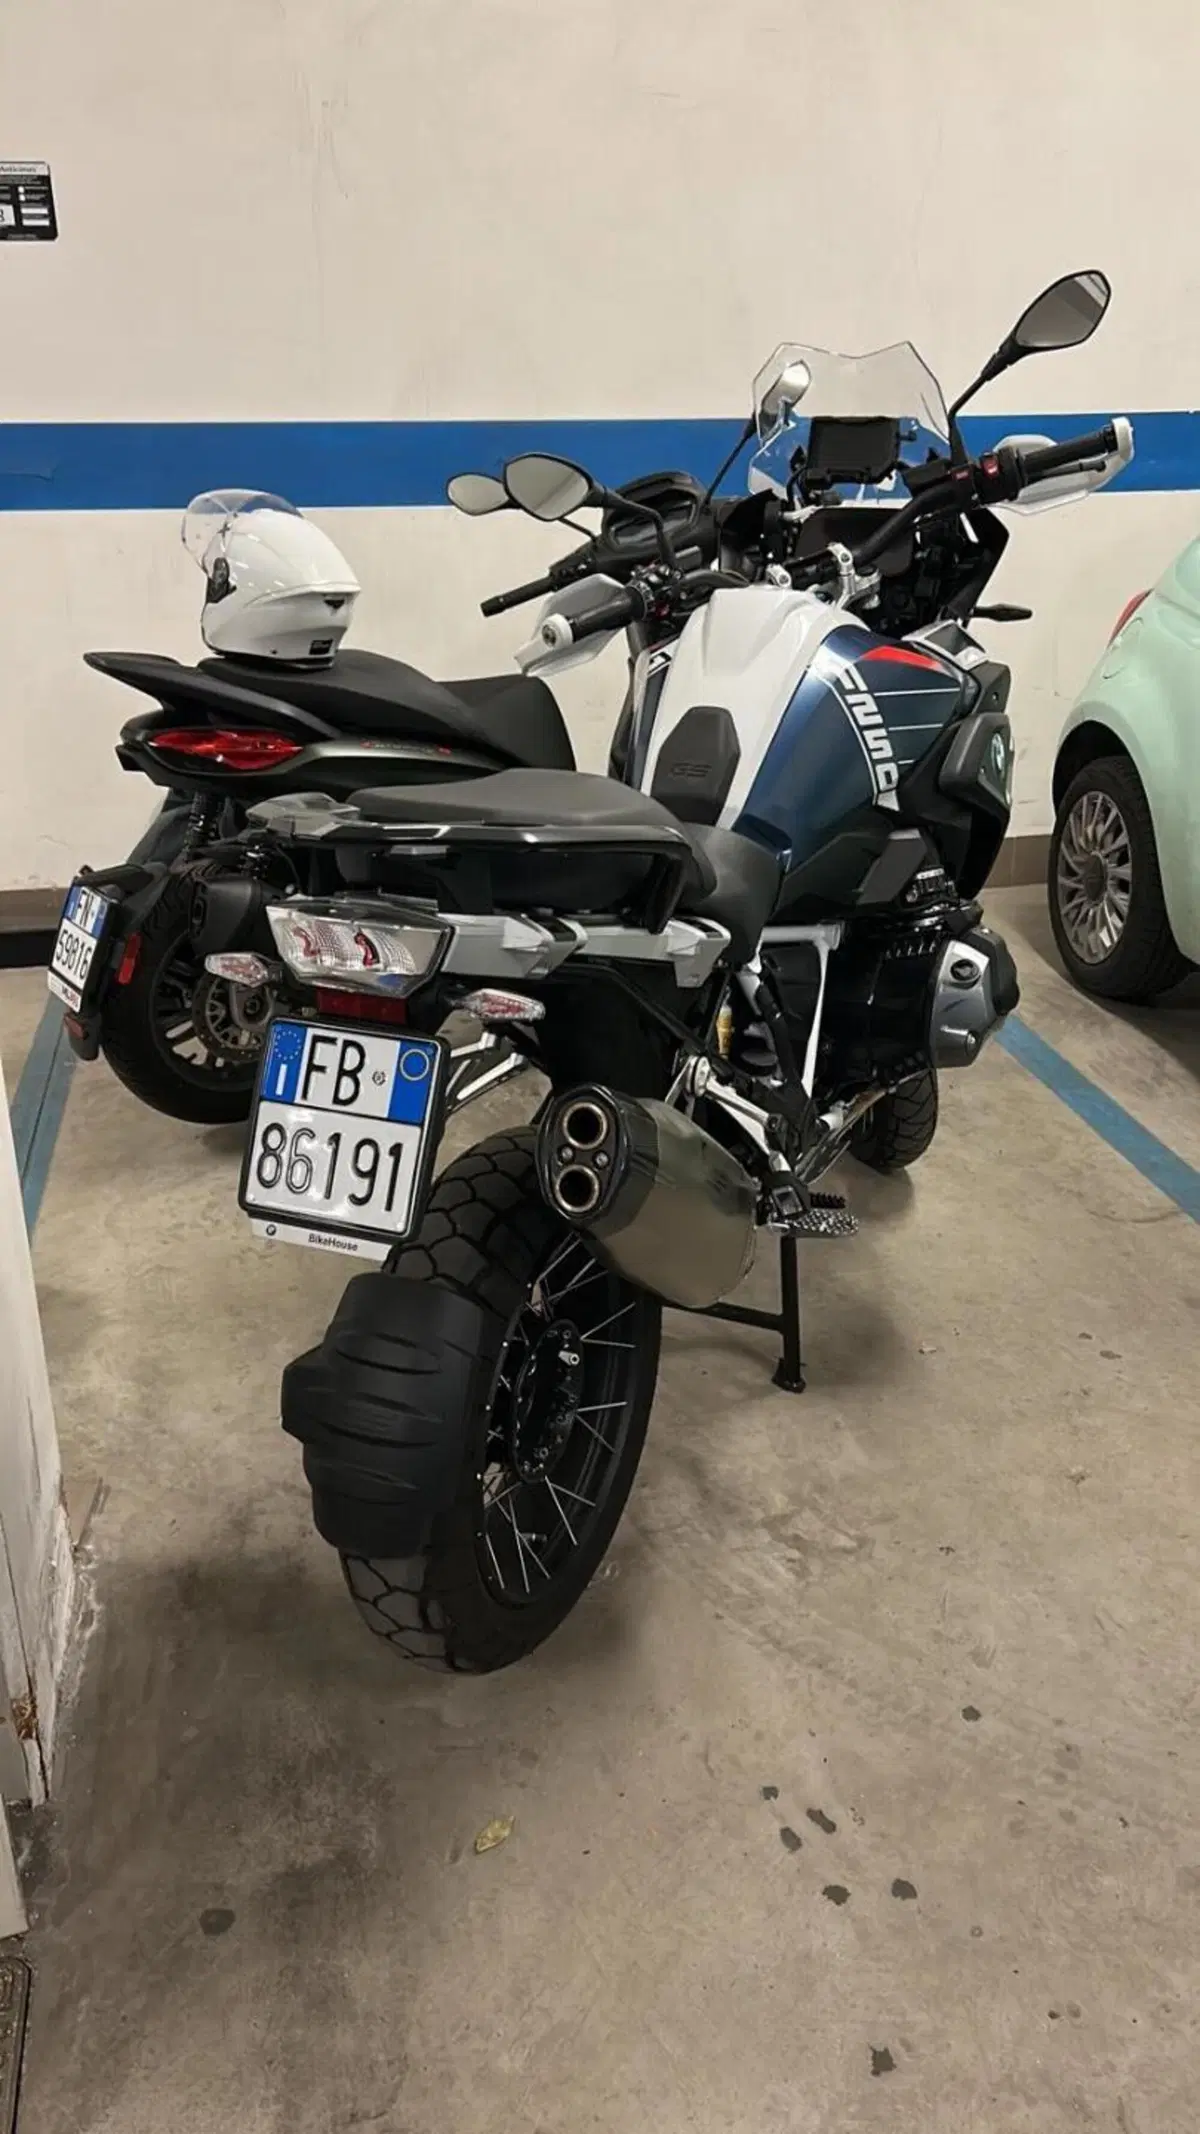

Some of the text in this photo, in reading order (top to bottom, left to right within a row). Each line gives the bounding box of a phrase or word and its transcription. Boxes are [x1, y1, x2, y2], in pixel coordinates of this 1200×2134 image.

[671, 762, 712, 778] GS
[56, 931, 92, 979] 59816
[302, 1033, 366, 1106] FB
[256, 1122, 404, 1212] 86191
[308, 1233, 359, 1252] BikeHouse
